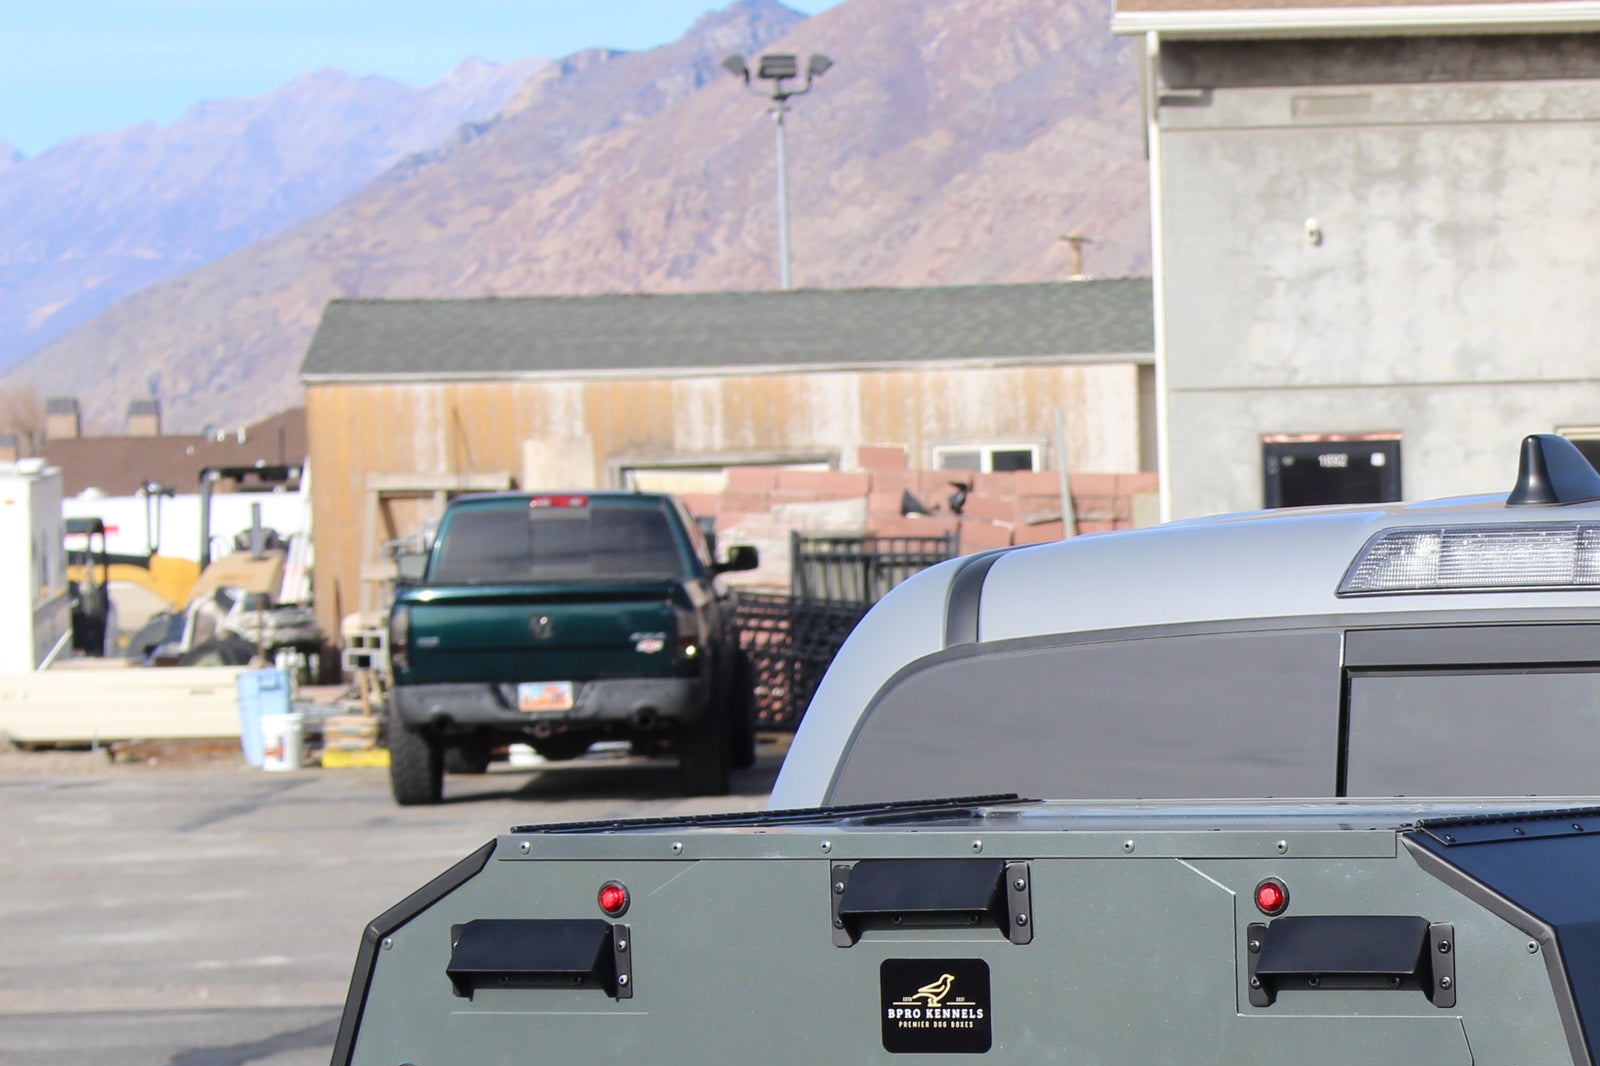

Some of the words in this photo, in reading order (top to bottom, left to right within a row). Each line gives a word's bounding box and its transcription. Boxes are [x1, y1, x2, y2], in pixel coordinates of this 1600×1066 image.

[887, 1008, 921, 1019] BPRO
[926, 1008, 984, 1019] KENNELS
[898, 1020, 930, 1028] PREMIER
[933, 1020, 948, 1028] DOG
[950, 1020, 974, 1028] BOXES
